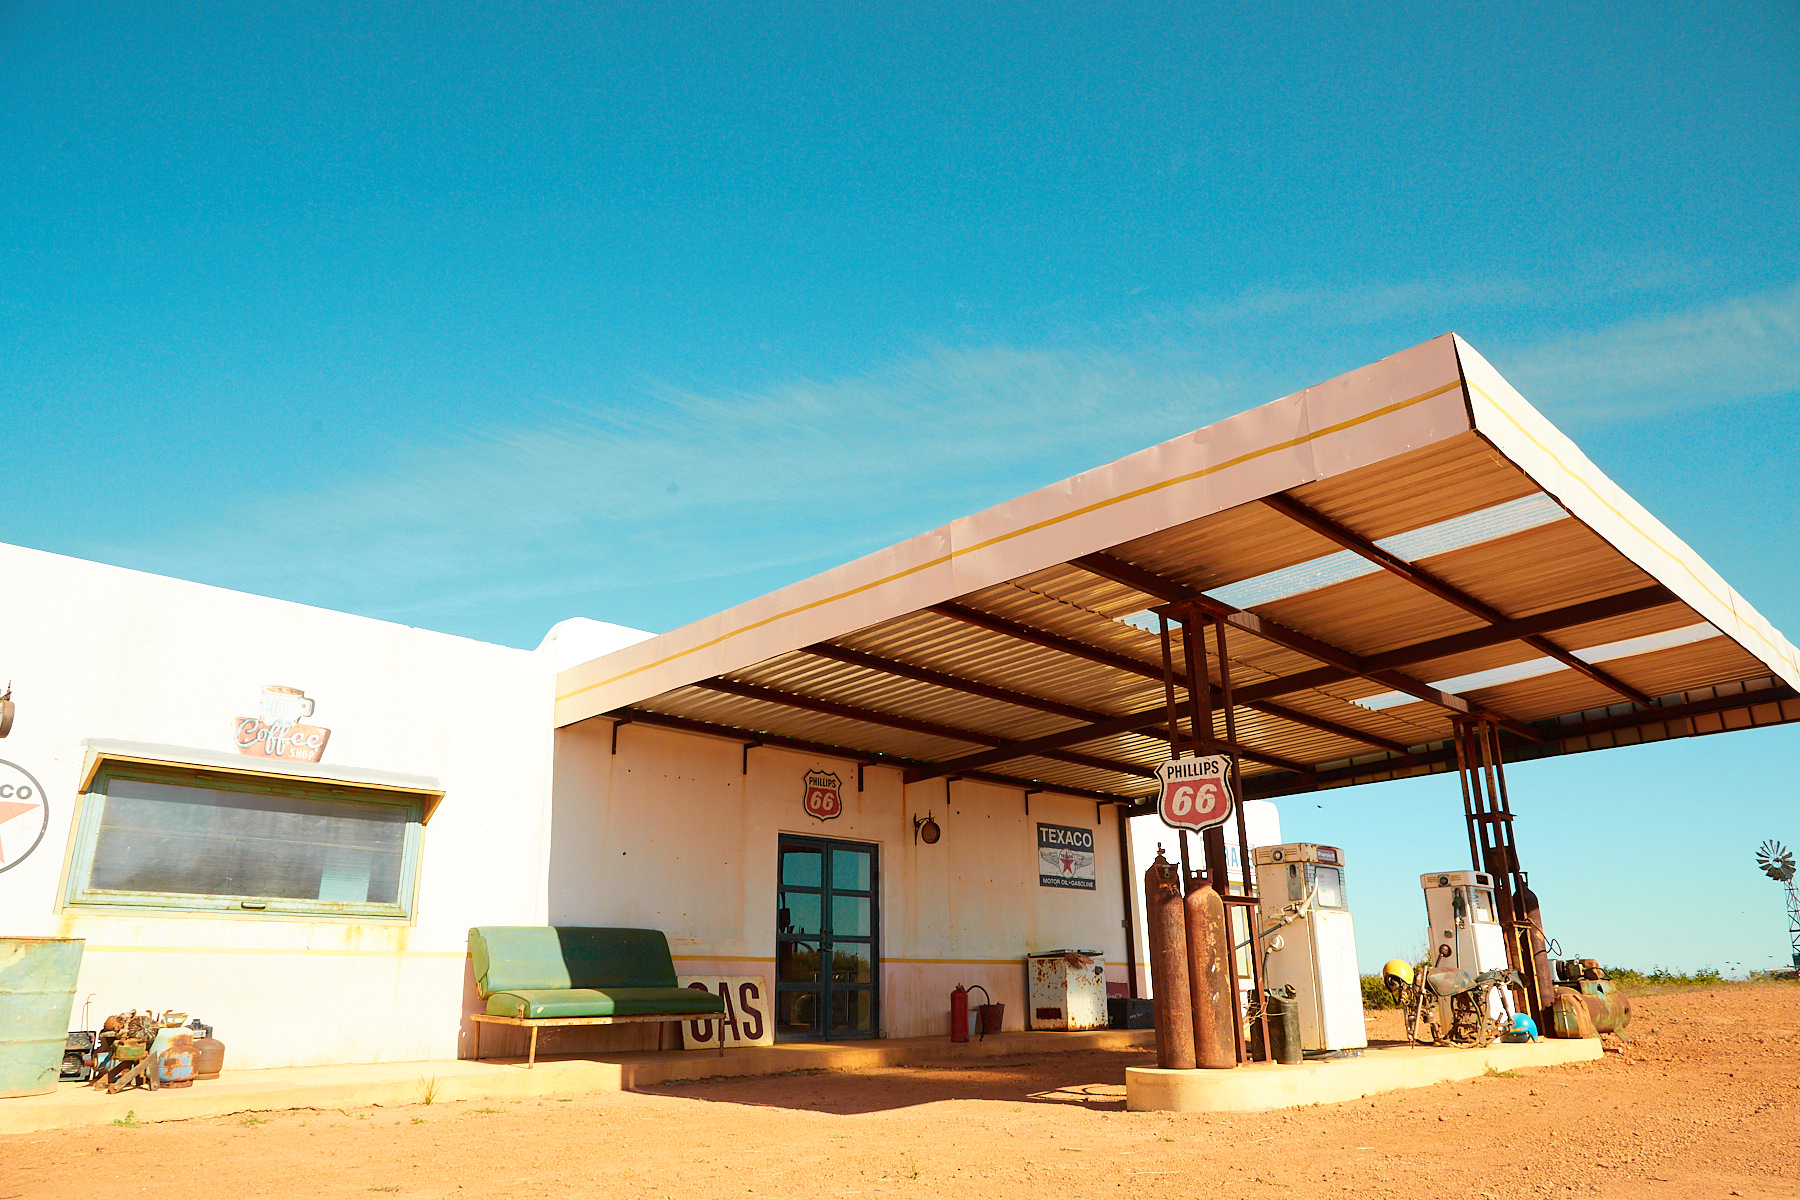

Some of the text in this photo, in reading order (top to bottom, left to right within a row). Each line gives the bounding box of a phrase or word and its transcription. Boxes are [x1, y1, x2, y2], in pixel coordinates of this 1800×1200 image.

[263, 695, 299, 719] HOT
[234, 718, 323, 756] Coffee
[289, 748, 315, 760] SHOP
[1167, 760, 1219, 779] PHILLIPS
[809, 776, 836, 788] PHILLIPS
[810, 790, 835, 811] 66
[1172, 783, 1218, 816] 66
[1039, 827, 1092, 847] TEXACO
